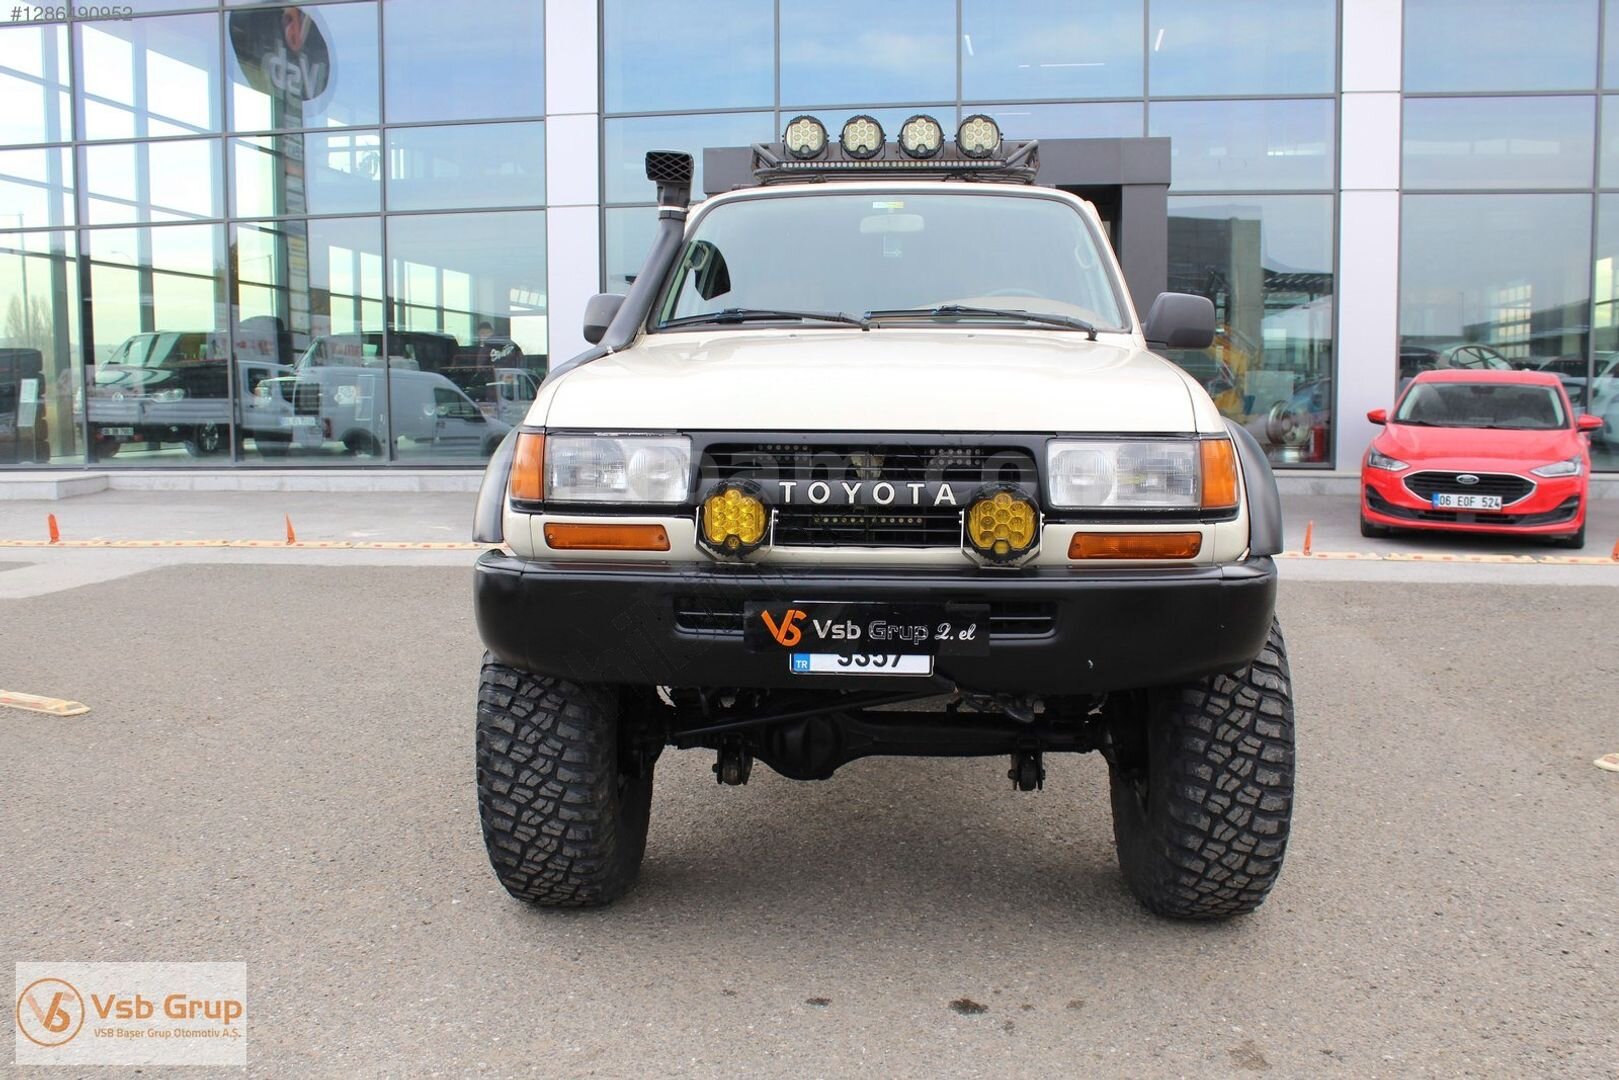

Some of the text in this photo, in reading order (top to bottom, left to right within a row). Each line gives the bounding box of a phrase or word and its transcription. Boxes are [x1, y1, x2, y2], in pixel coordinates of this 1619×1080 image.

[779, 481, 957, 506] TOYOTA
[1439, 495, 1451, 506] 06
[1482, 497, 1500, 508] 524
[812, 619, 862, 639] Vsb
[868, 620, 929, 645] Grup
[795, 660, 808, 669] TR
